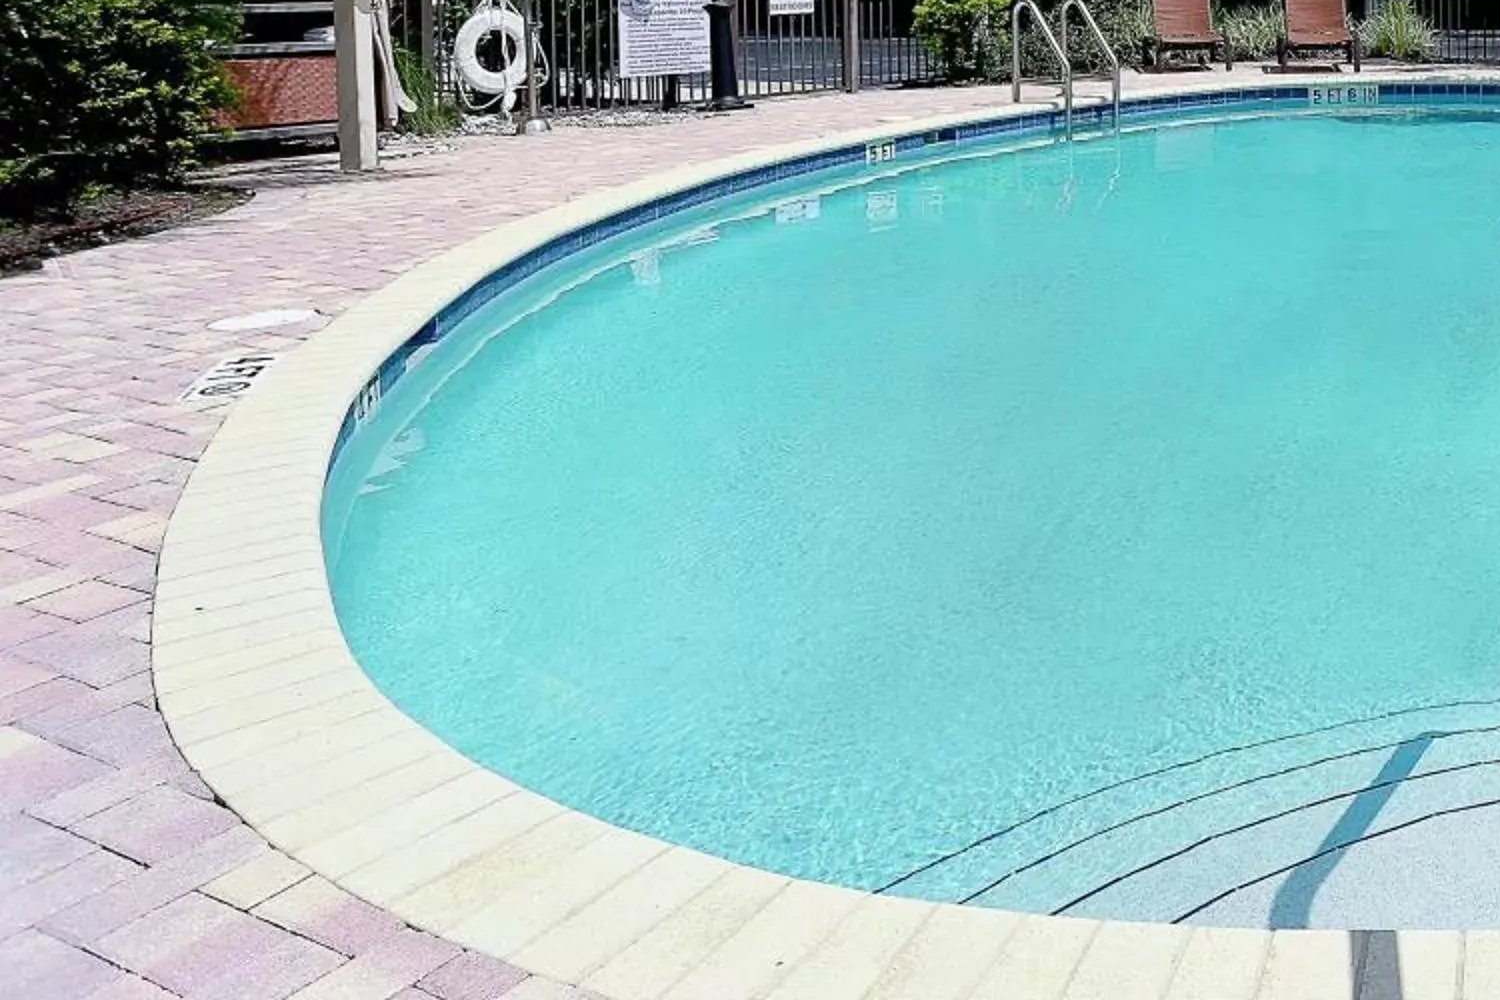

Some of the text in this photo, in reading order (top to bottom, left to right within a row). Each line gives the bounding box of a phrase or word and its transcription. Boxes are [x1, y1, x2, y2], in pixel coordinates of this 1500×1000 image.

[1313, 89, 1322, 104] 5
[1363, 87, 1377, 104] IN
[870, 145, 877, 160] 5
